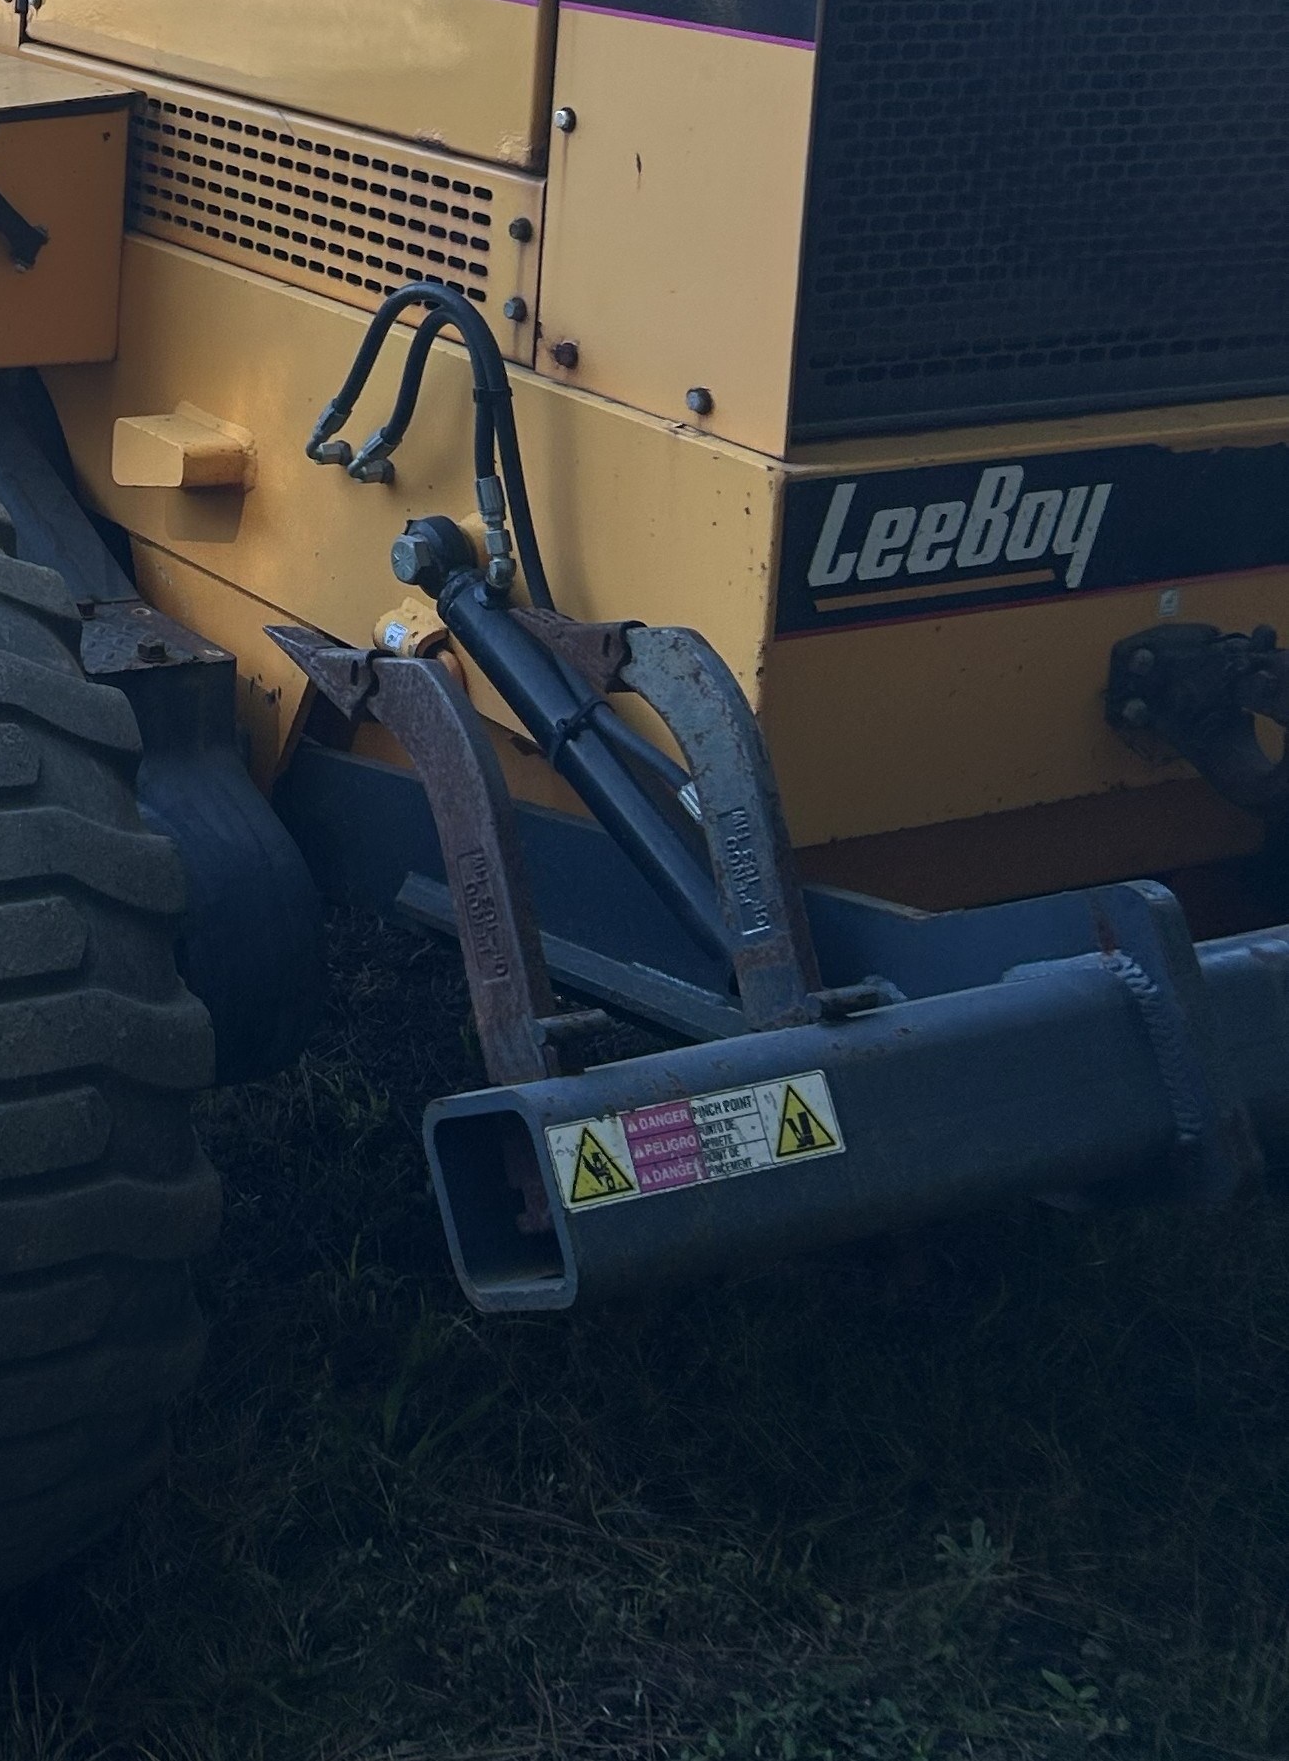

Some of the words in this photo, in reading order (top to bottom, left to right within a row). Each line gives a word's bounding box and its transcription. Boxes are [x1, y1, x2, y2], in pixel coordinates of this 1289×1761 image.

[807, 464, 1114, 589] LeeBoy
[692, 1102, 723, 1119] PINCH
[723, 1095, 753, 1113] POINT
[638, 1108, 690, 1130] DANGER
[644, 1134, 697, 1157] PELIGRO
